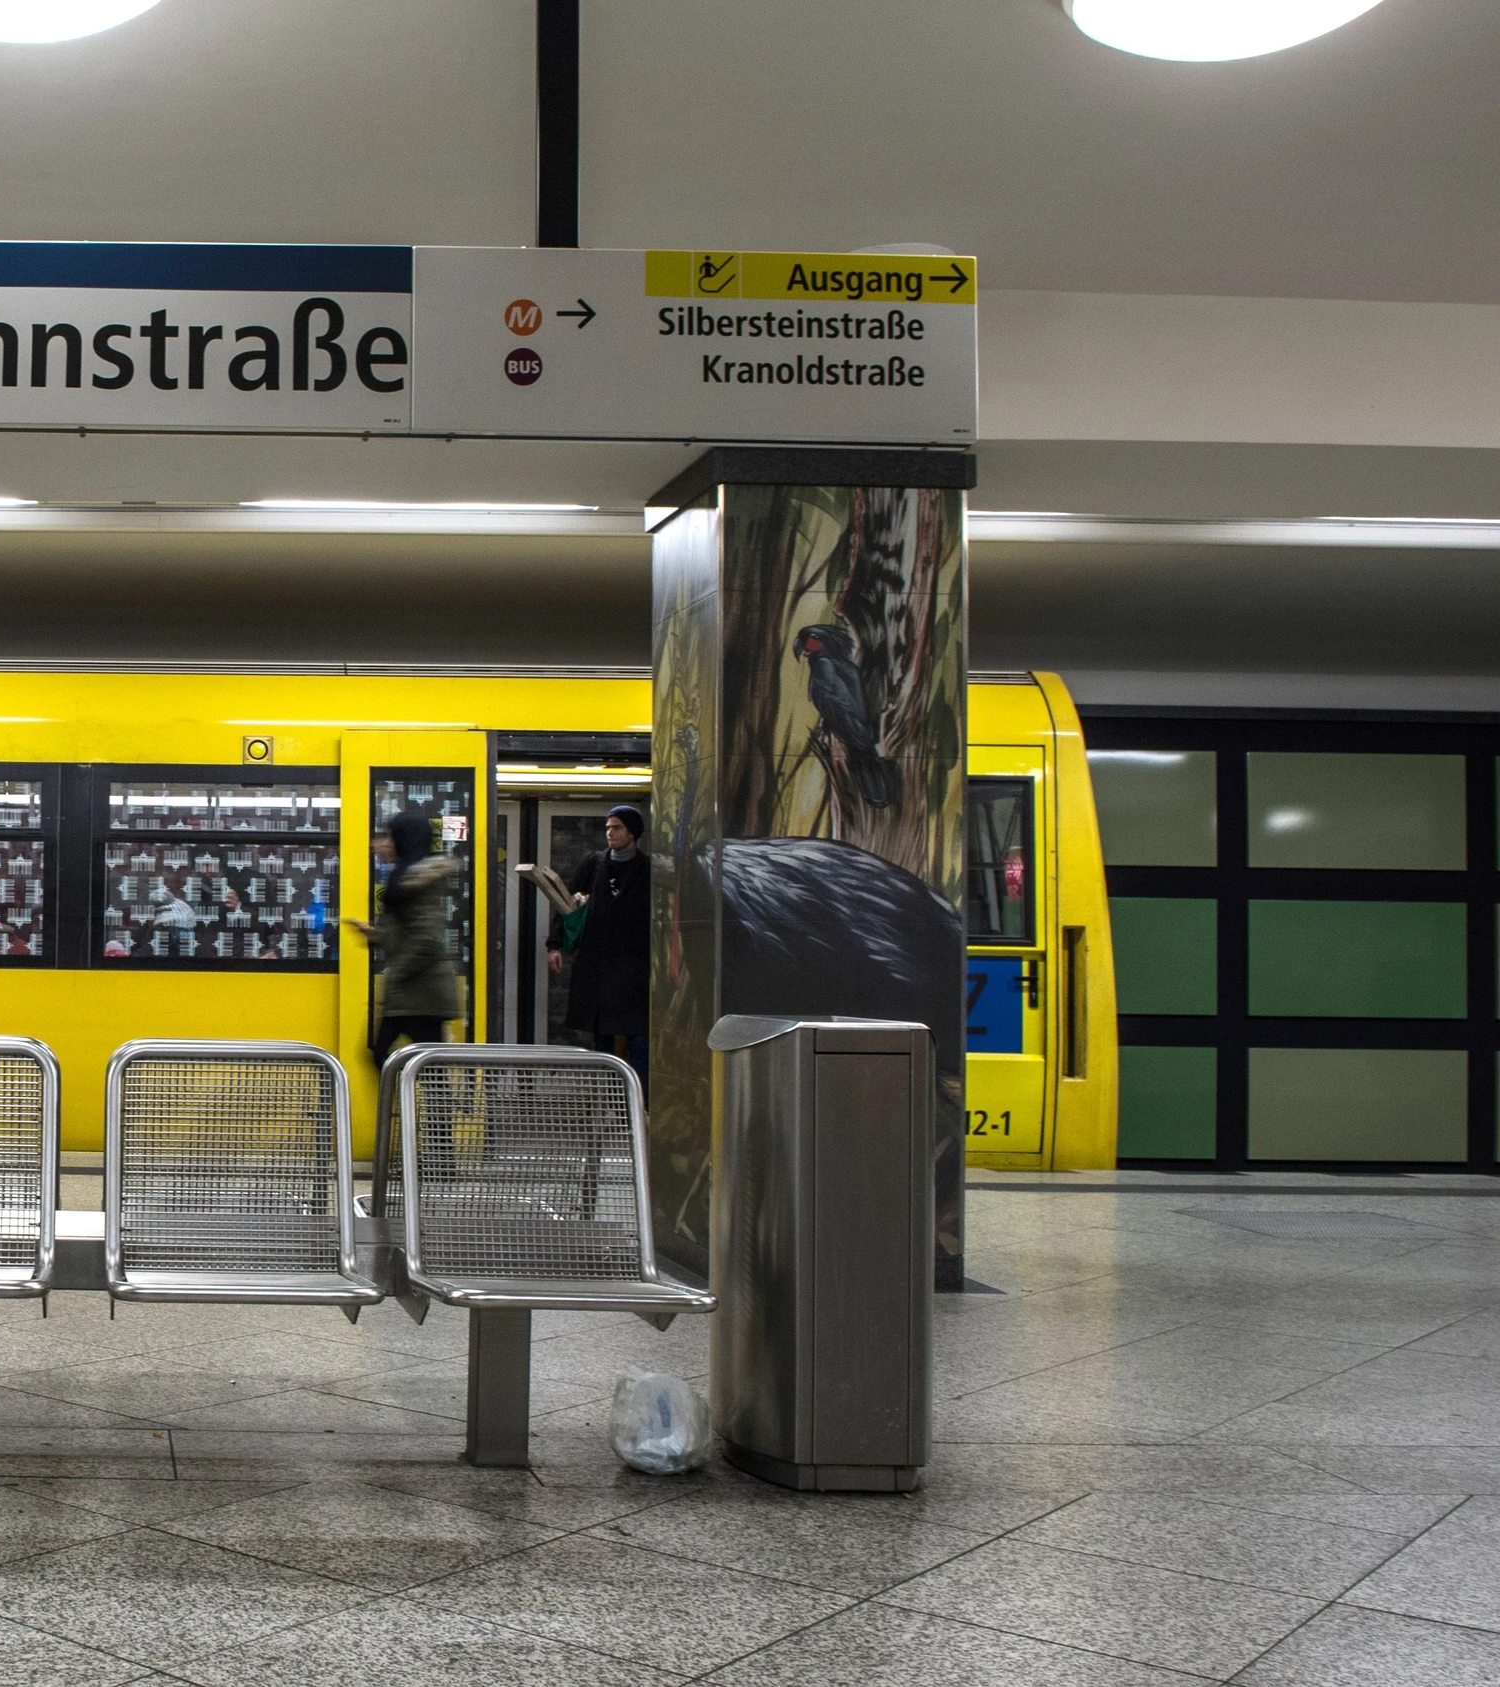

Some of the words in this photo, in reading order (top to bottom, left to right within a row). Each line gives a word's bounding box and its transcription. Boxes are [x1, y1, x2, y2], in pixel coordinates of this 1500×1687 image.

[786, 263, 923, 302] Ausgang
[507, 305, 538, 328] M
[658, 305, 925, 341] Silbersteinstraße
[507, 360, 541, 374] BUS
[701, 353, 925, 388] Kranoldstraße
